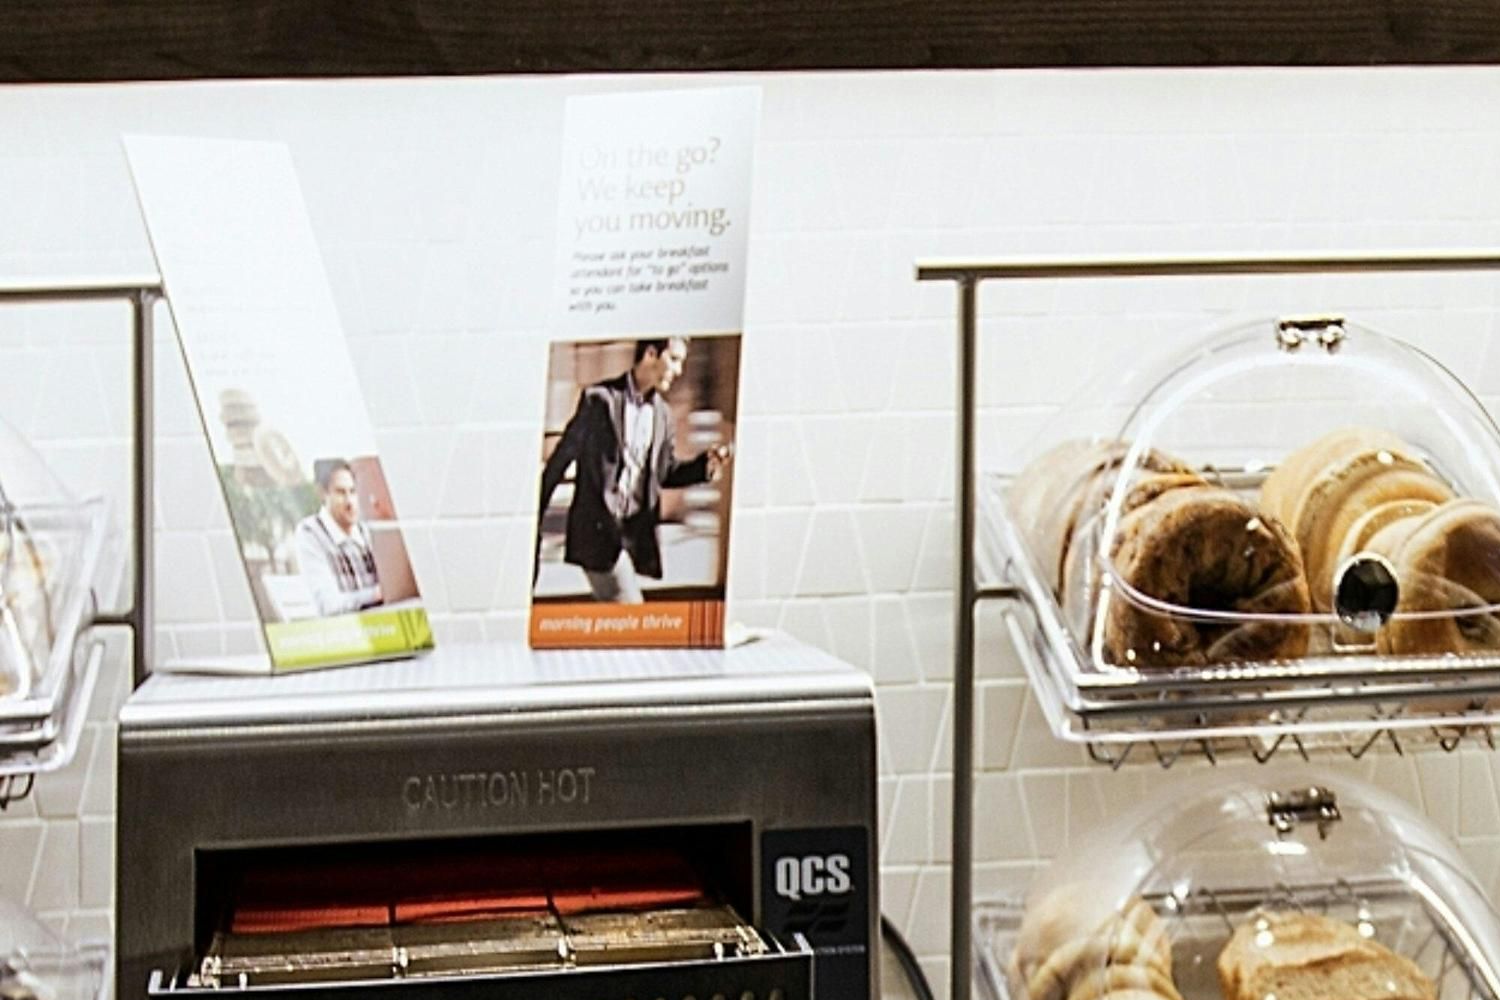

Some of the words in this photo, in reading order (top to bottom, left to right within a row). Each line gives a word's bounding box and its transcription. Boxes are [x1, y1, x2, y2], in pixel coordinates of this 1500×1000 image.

[579, 145, 616, 170] On
[627, 143, 669, 168] the
[676, 136, 721, 174] go?
[577, 174, 618, 201] We
[624, 173, 685, 205] keep
[575, 213, 621, 241] you
[629, 202, 731, 237] moving.
[630, 250, 653, 265] your
[657, 245, 710, 259] breakfast
[626, 265, 642, 280] for
[688, 262, 729, 275] options
[583, 286, 602, 297] you
[607, 284, 626, 295] can
[629, 280, 653, 293] take
[656, 278, 709, 293] breakfast
[569, 301, 592, 311] with
[539, 616, 592, 634] morning
[594, 615, 639, 633] people
[642, 613, 682, 629] thrive
[401, 770, 528, 811] CAUTION
[537, 766, 595, 806] HOT
[776, 854, 851, 899] QCS
